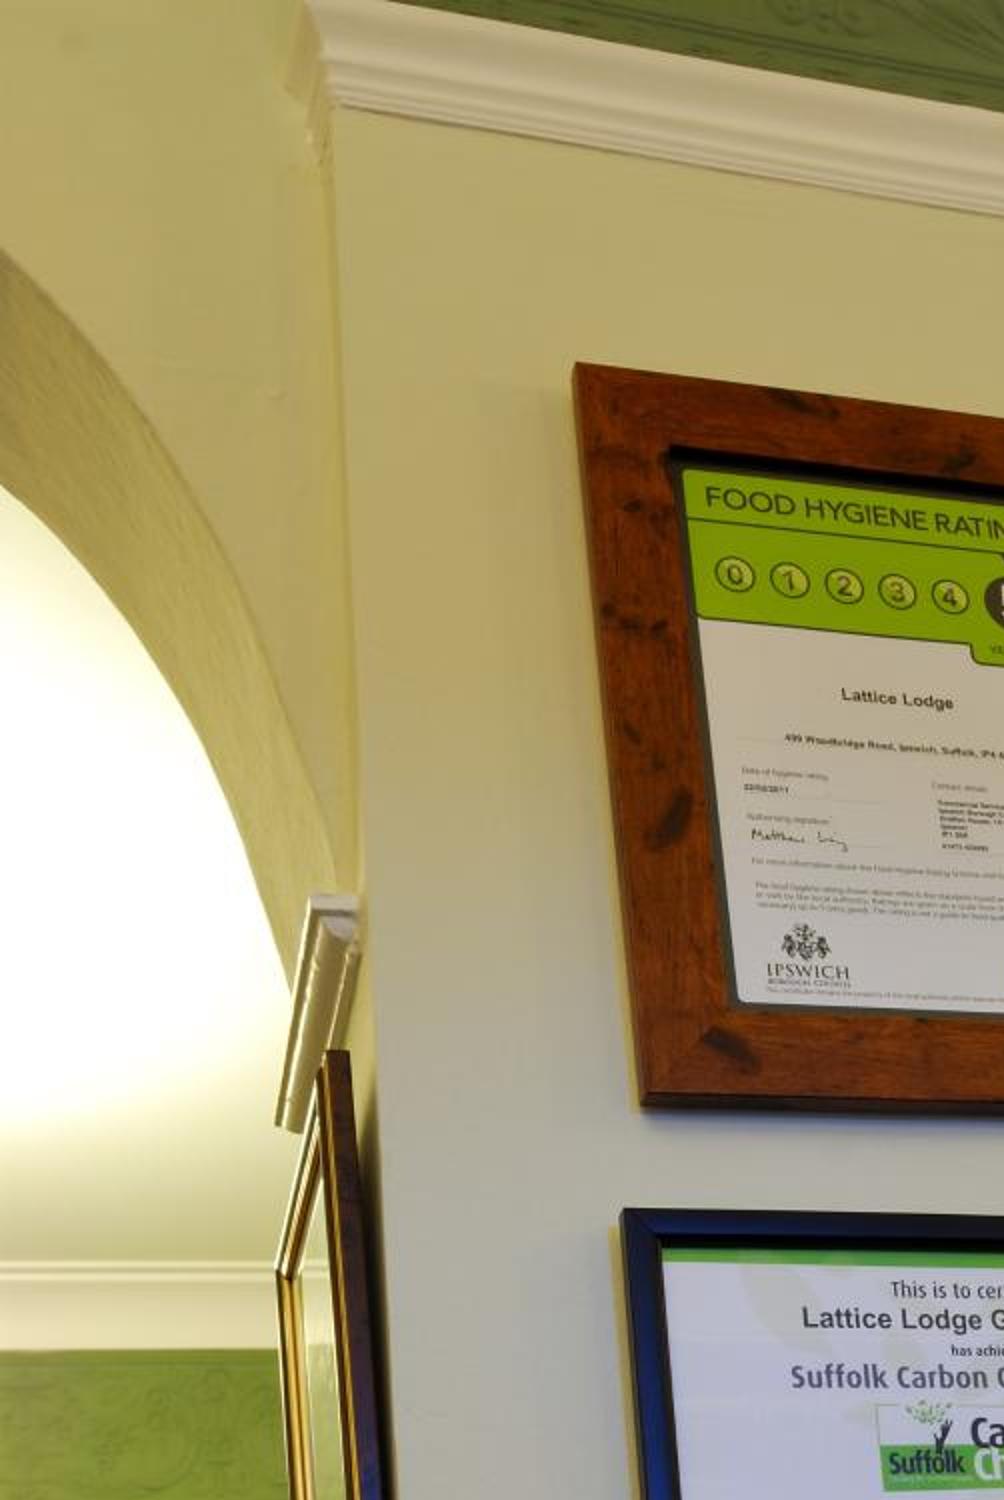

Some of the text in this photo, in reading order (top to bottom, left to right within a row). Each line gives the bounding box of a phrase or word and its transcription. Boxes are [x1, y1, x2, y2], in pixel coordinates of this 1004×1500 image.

[705, 487, 795, 515] FOOD
[804, 498, 928, 531] HYGIENE
[841, 688, 953, 711] Lattice Lodge
[767, 963, 849, 980] IPSWICH
[891, 1281, 928, 1299] This
[933, 1282, 948, 1298] is
[953, 1283, 971, 1299] to
[802, 1307, 893, 1330] Lattice
[902, 1308, 982, 1334] Lodge
[951, 1345, 972, 1357] has
[791, 1365, 887, 1390] Suffolk
[897, 1365, 988, 1390] Carbon
[889, 1450, 966, 1476] Suffolk
